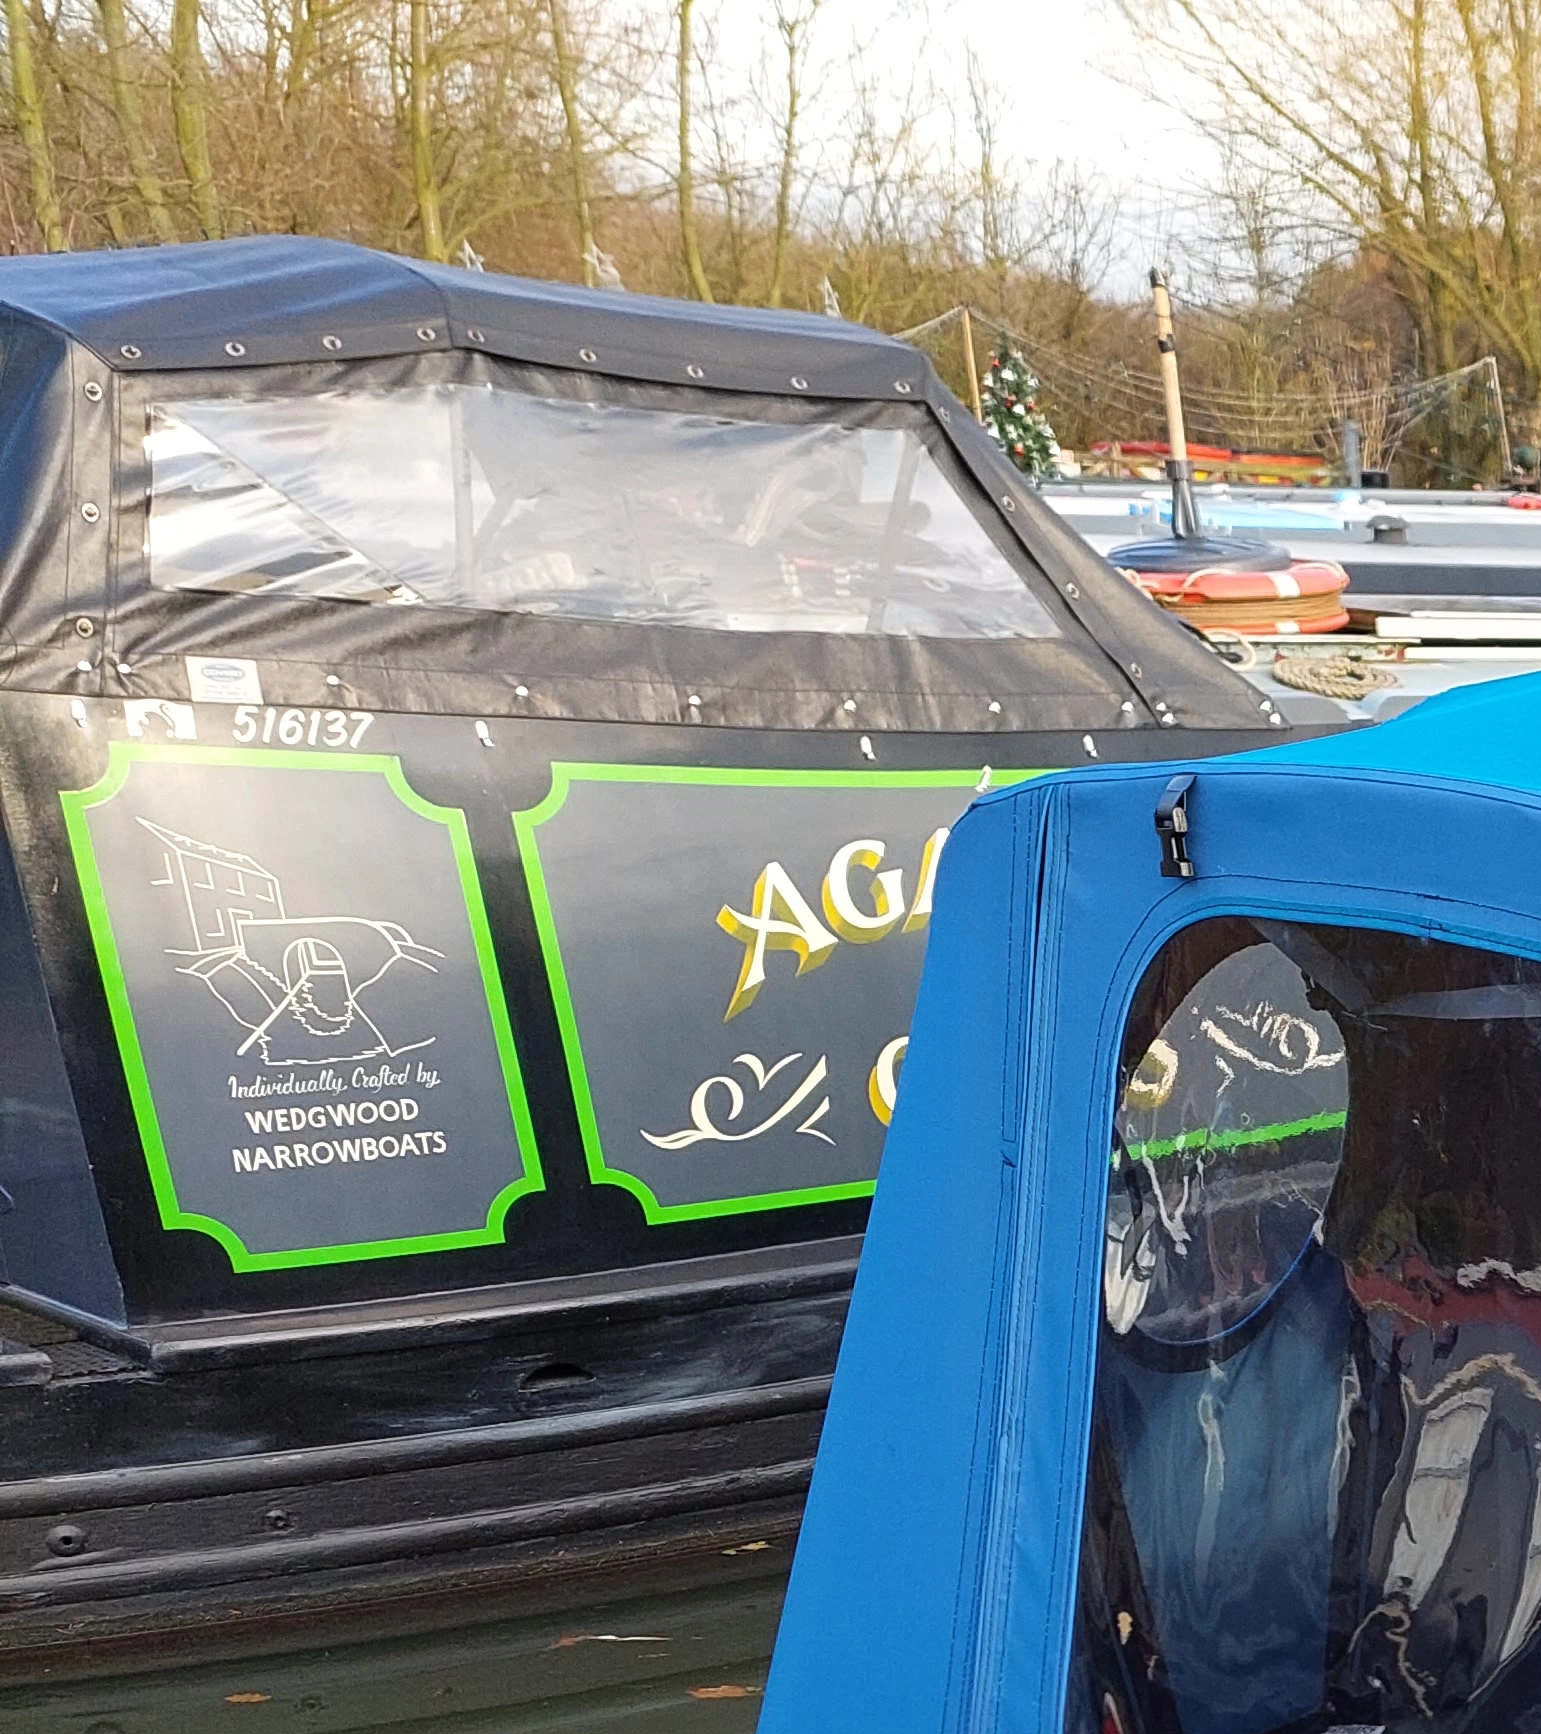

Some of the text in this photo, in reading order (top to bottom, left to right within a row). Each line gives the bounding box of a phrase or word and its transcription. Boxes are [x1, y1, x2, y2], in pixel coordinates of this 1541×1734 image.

[232, 705, 375, 749] 516137
[228, 1069, 348, 1098] Individually
[351, 1063, 410, 1093] Crafted
[244, 1098, 419, 1134] WEDGWOOD
[231, 1131, 447, 1173] NARROWBOATS
